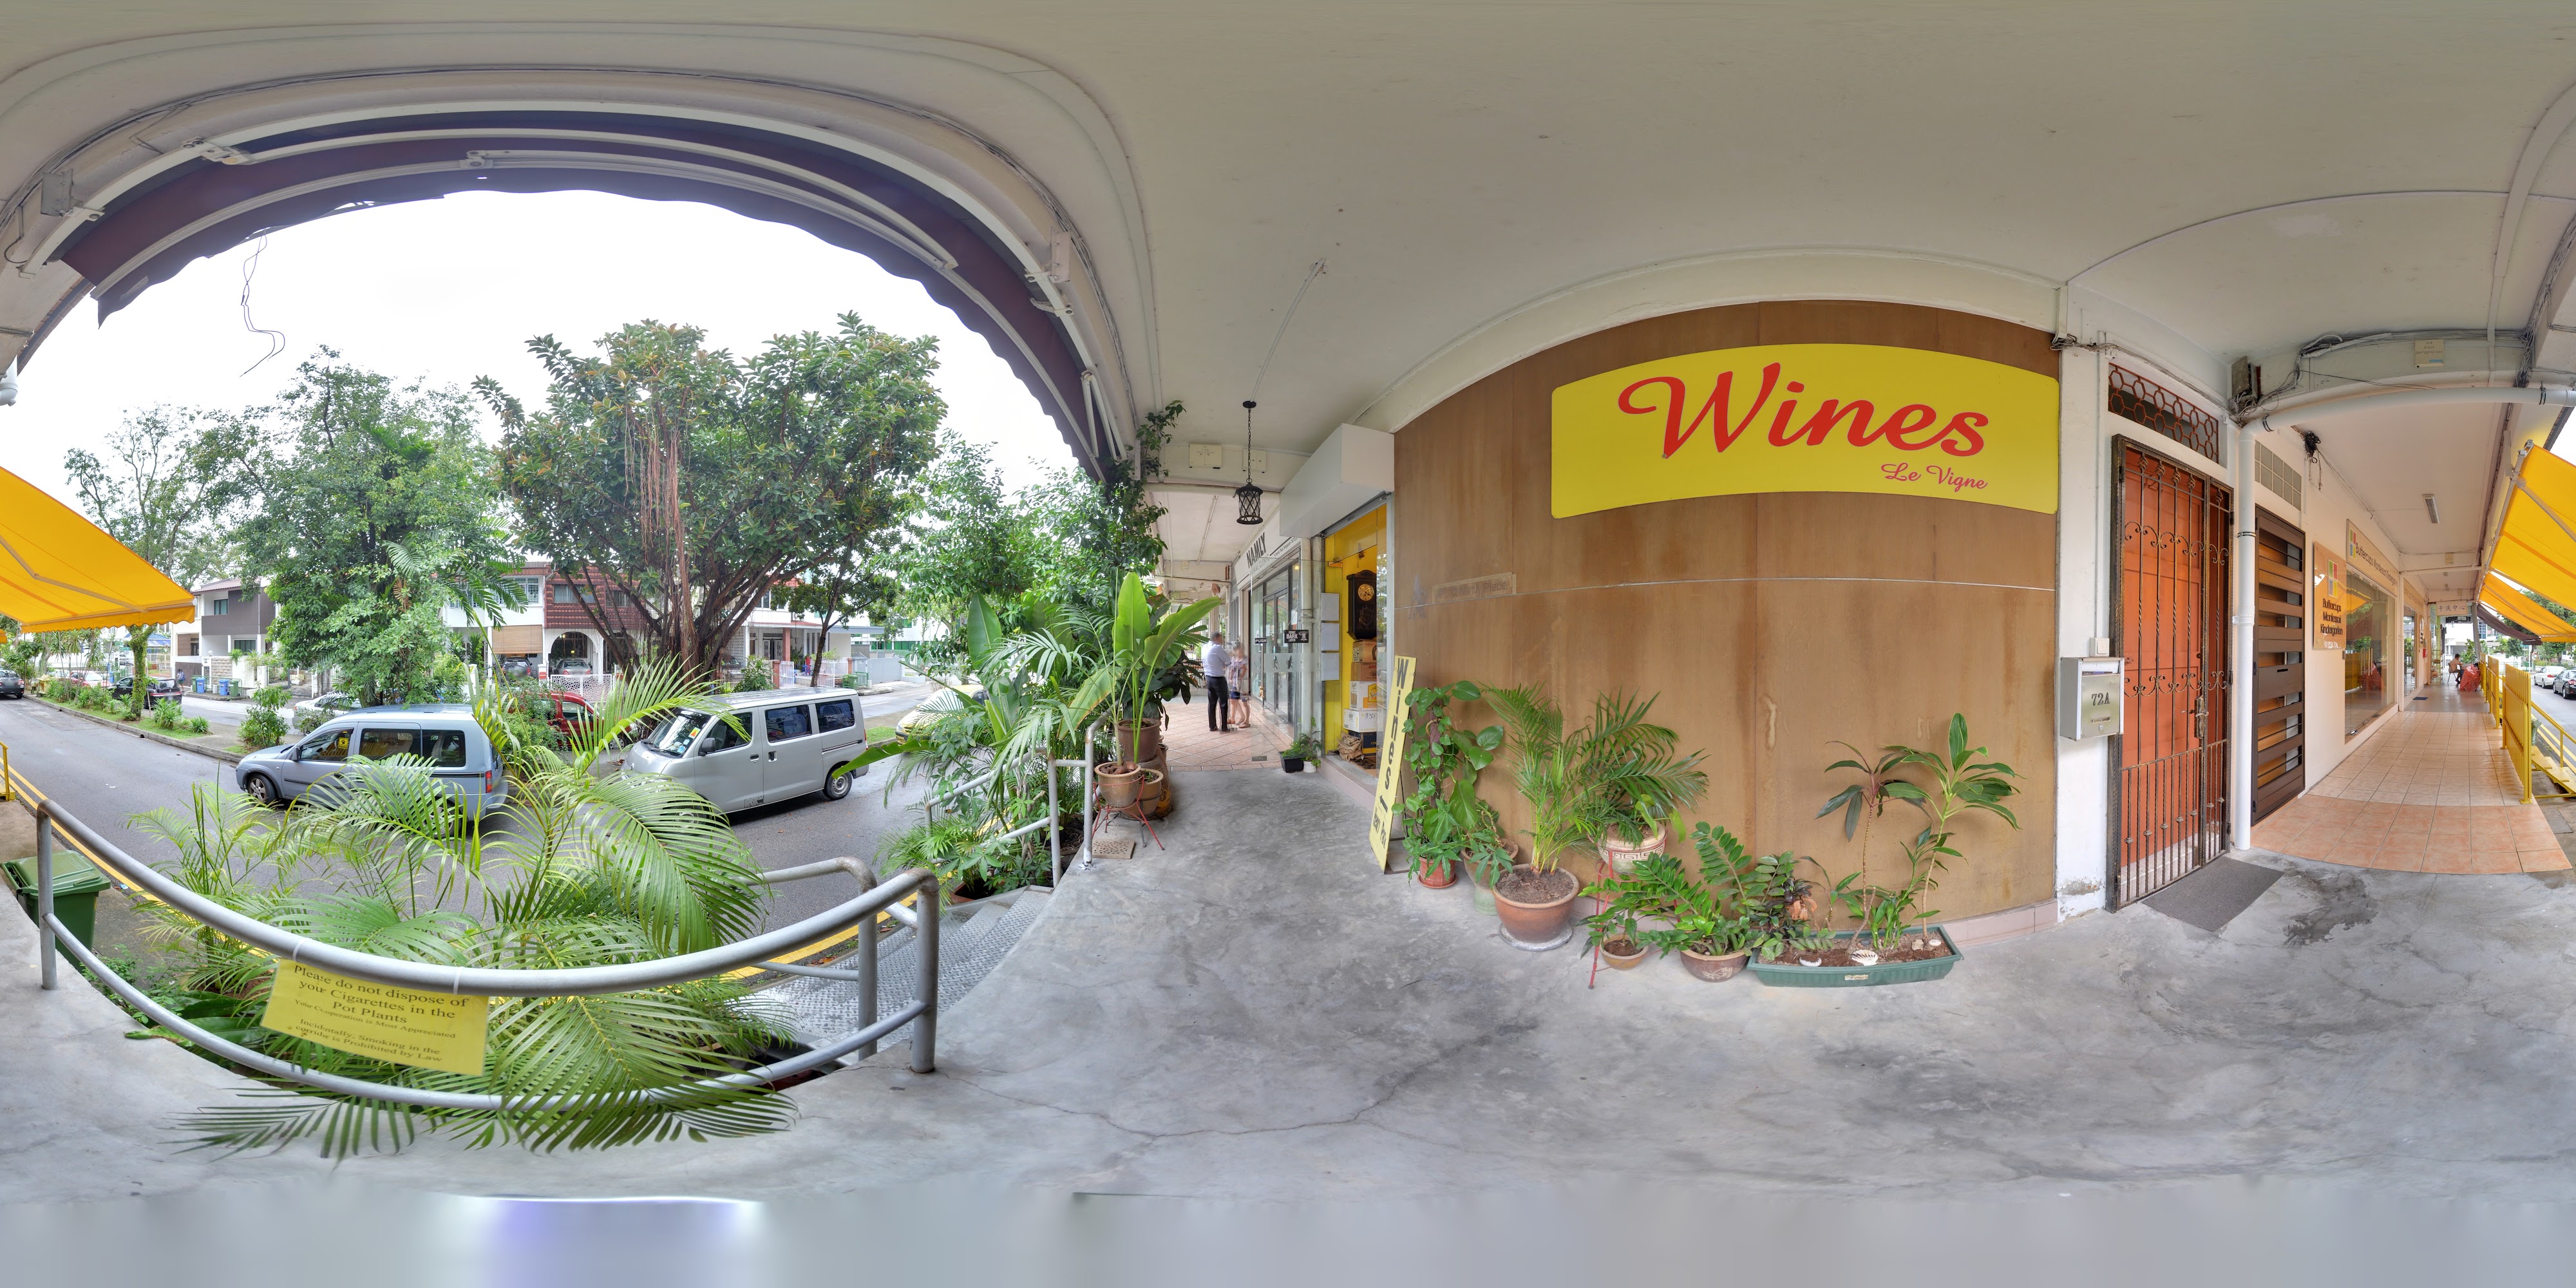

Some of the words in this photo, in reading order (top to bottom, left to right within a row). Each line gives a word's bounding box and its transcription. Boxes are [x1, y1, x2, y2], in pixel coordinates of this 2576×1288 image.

[1618, 362, 1990, 459] Wines
[1881, 462, 1921, 482] Le
[1926, 465, 1989, 493] Vigne
[1246, 532, 1266, 569] NAMLY
[1259, 553, 1270, 569] CLINIC
[2356, 542, 2373, 567] Buttercups
[2323, 598, 2342, 613] Buttercups
[2323, 611, 2342, 624] Montessori
[2320, 623, 2344, 637] Kindergarten
[2091, 692, 2110, 706] 72A
[1385, 658, 1409, 790] Wines
[294, 965, 331, 984] Please
[336, 979, 352, 989] do
[357, 985, 381, 995] not
[386, 989, 444, 1004] dispose
[450, 998, 469, 1007] of
[299, 981, 327, 993] your
[330, 990, 404, 1011] Cigarettes
[410, 1005, 425, 1014] in
[431, 1008, 455, 1018] the
[294, 999, 313, 1009] Your
[314, 1006, 363, 1023] Cooperation
[375, 1021, 397, 1029] Most
[400, 1026, 456, 1038] Appreciated
[333, 1001, 356, 1014] Pot
[361, 1008, 407, 1023] Plants
[343, 1038, 397, 1054] Prohibited
[417, 1054, 442, 1062] Law
[358, 1034, 406, 1050] Smoking
